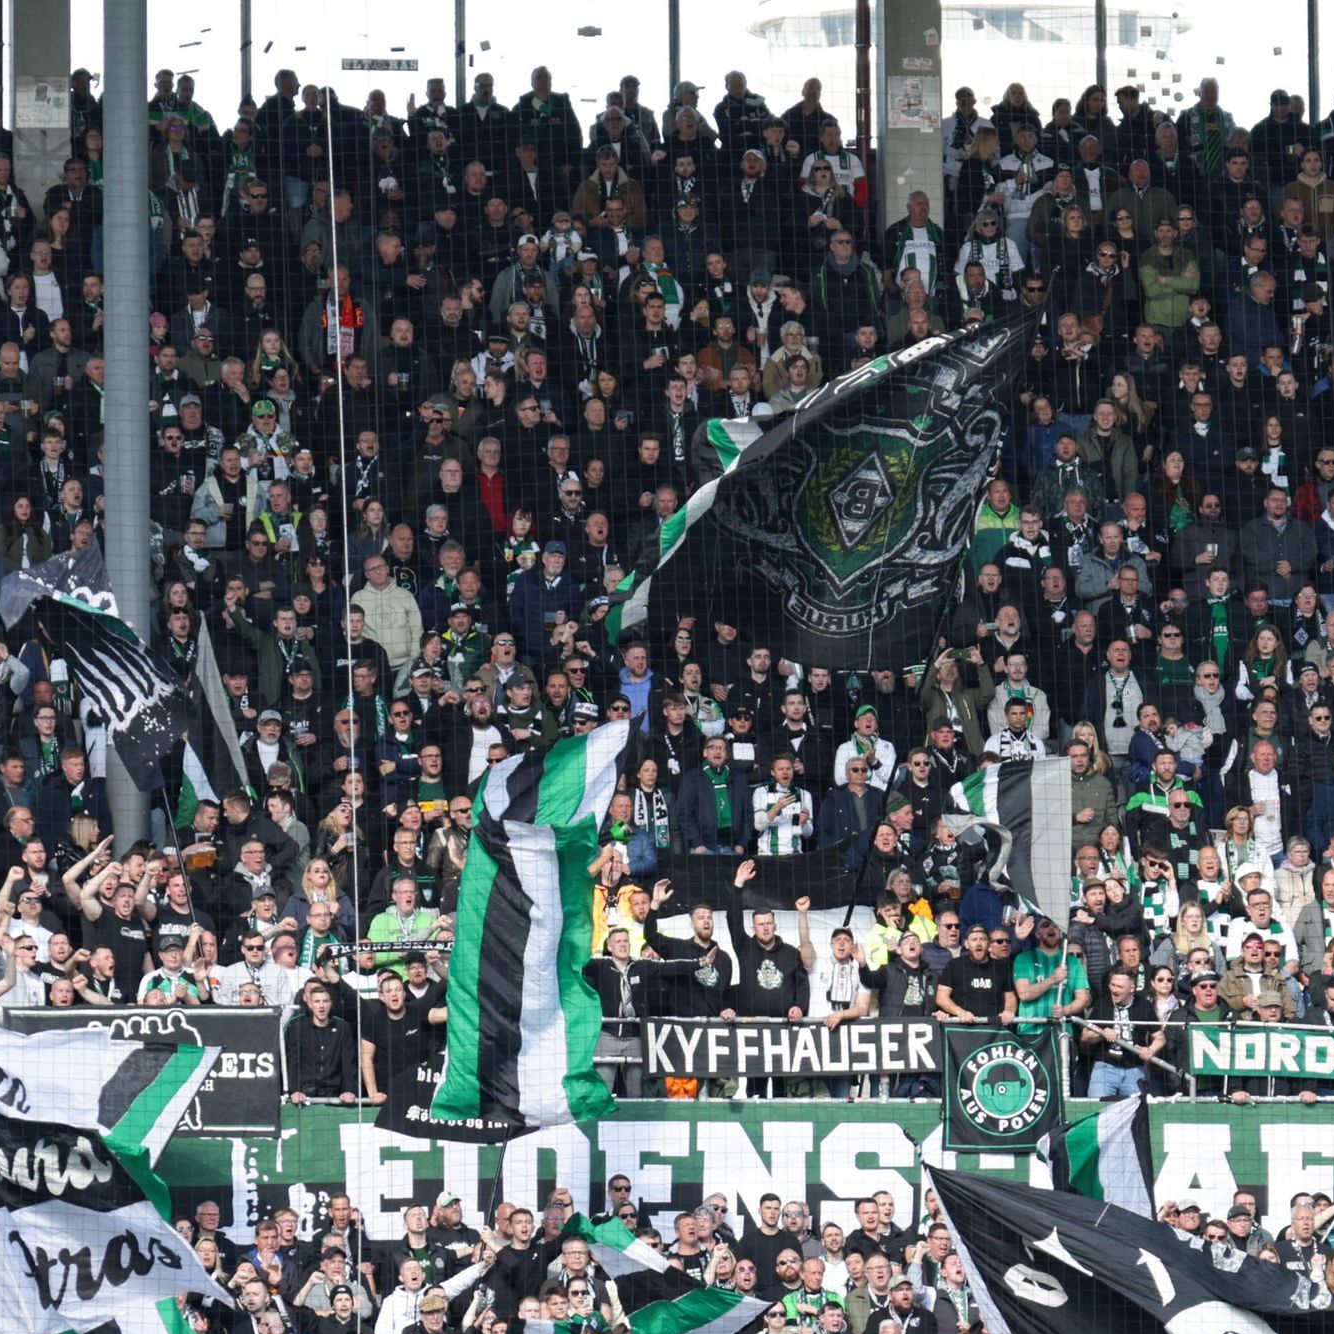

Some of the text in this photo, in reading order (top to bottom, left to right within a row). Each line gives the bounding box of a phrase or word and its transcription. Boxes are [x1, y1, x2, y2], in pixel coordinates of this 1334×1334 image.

[645, 1022, 935, 1075] KYFFHÄUSER
[966, 1044, 1038, 1074] FOHLEN
[960, 1088, 987, 1124] AUS
[998, 1088, 1048, 1132] POLEN
